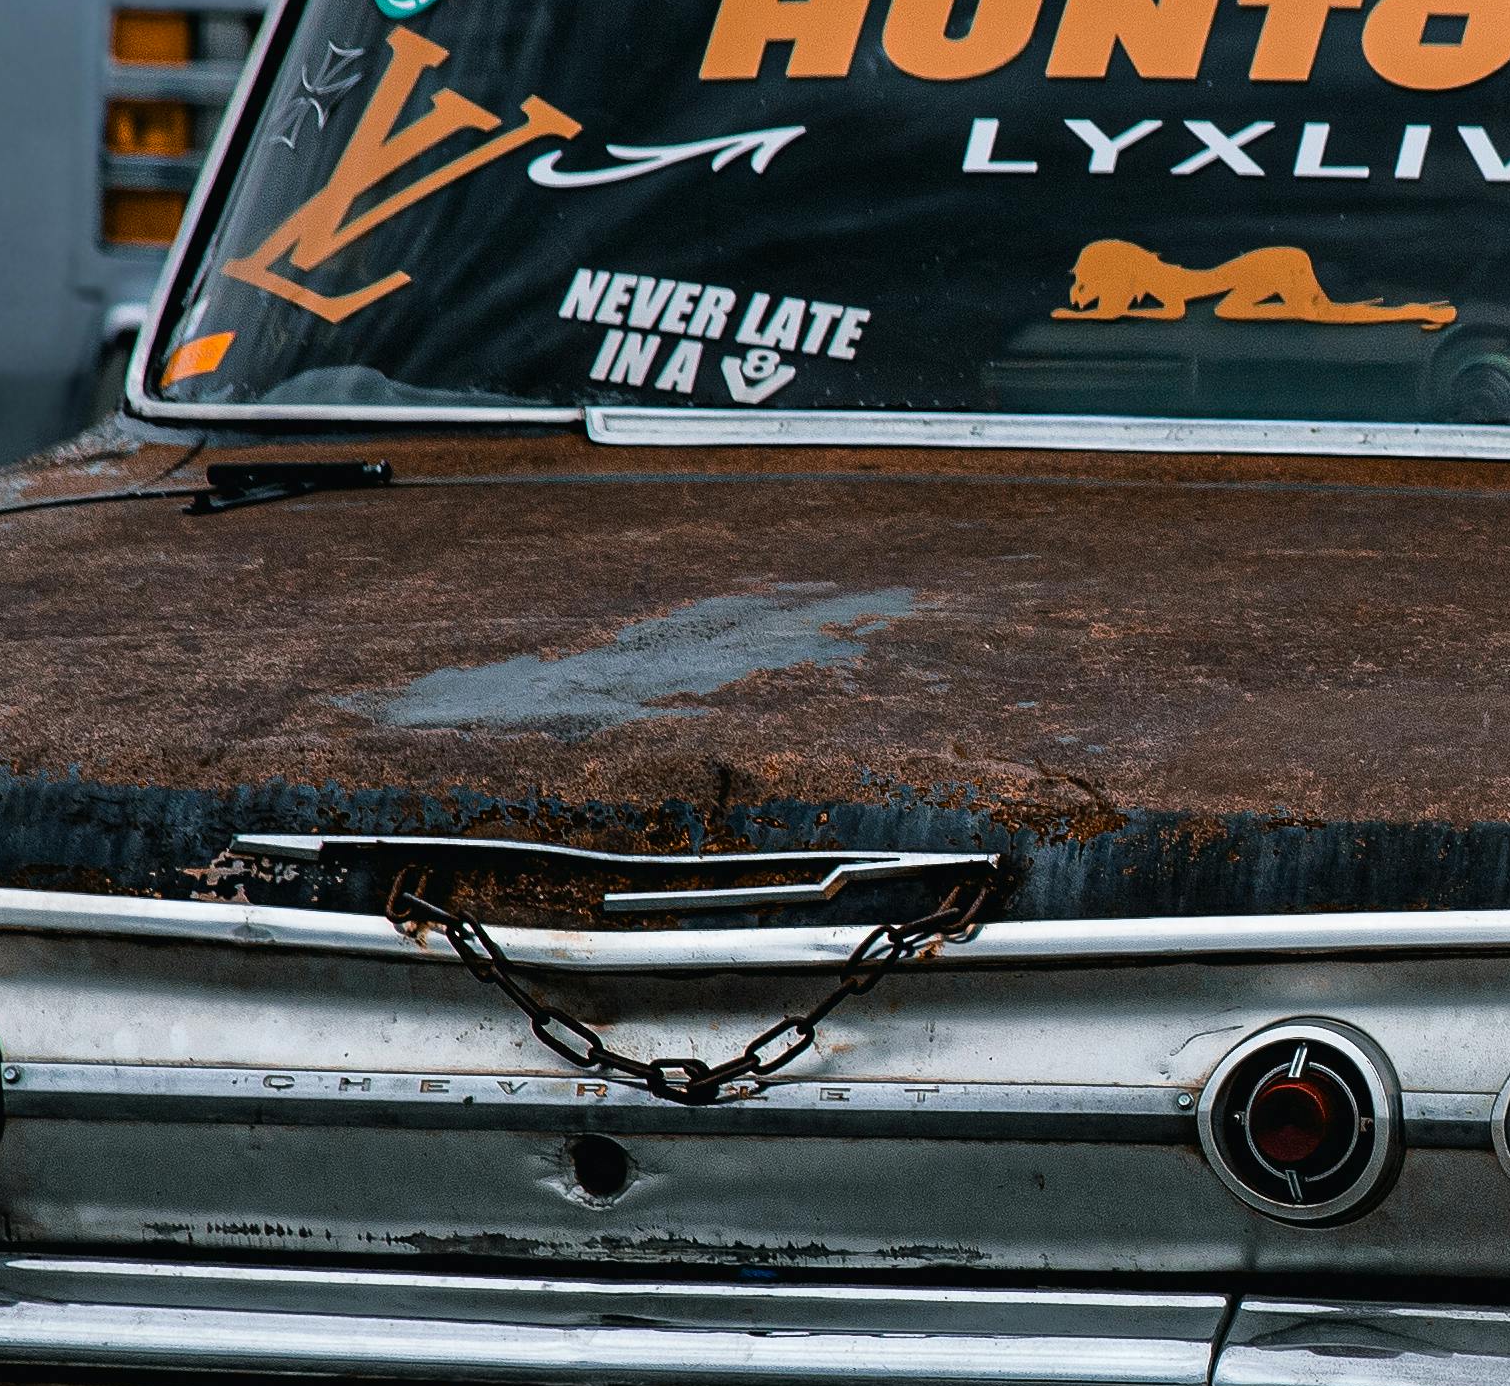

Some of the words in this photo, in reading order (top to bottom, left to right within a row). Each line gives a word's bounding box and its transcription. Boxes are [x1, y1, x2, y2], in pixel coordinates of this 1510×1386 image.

[558, 268, 737, 341] NEVER
[735, 291, 871, 361] LATE
[589, 328, 662, 387] IN
[654, 338, 704, 394] A
[262, 1072, 940, 1105] CHEVRLET
